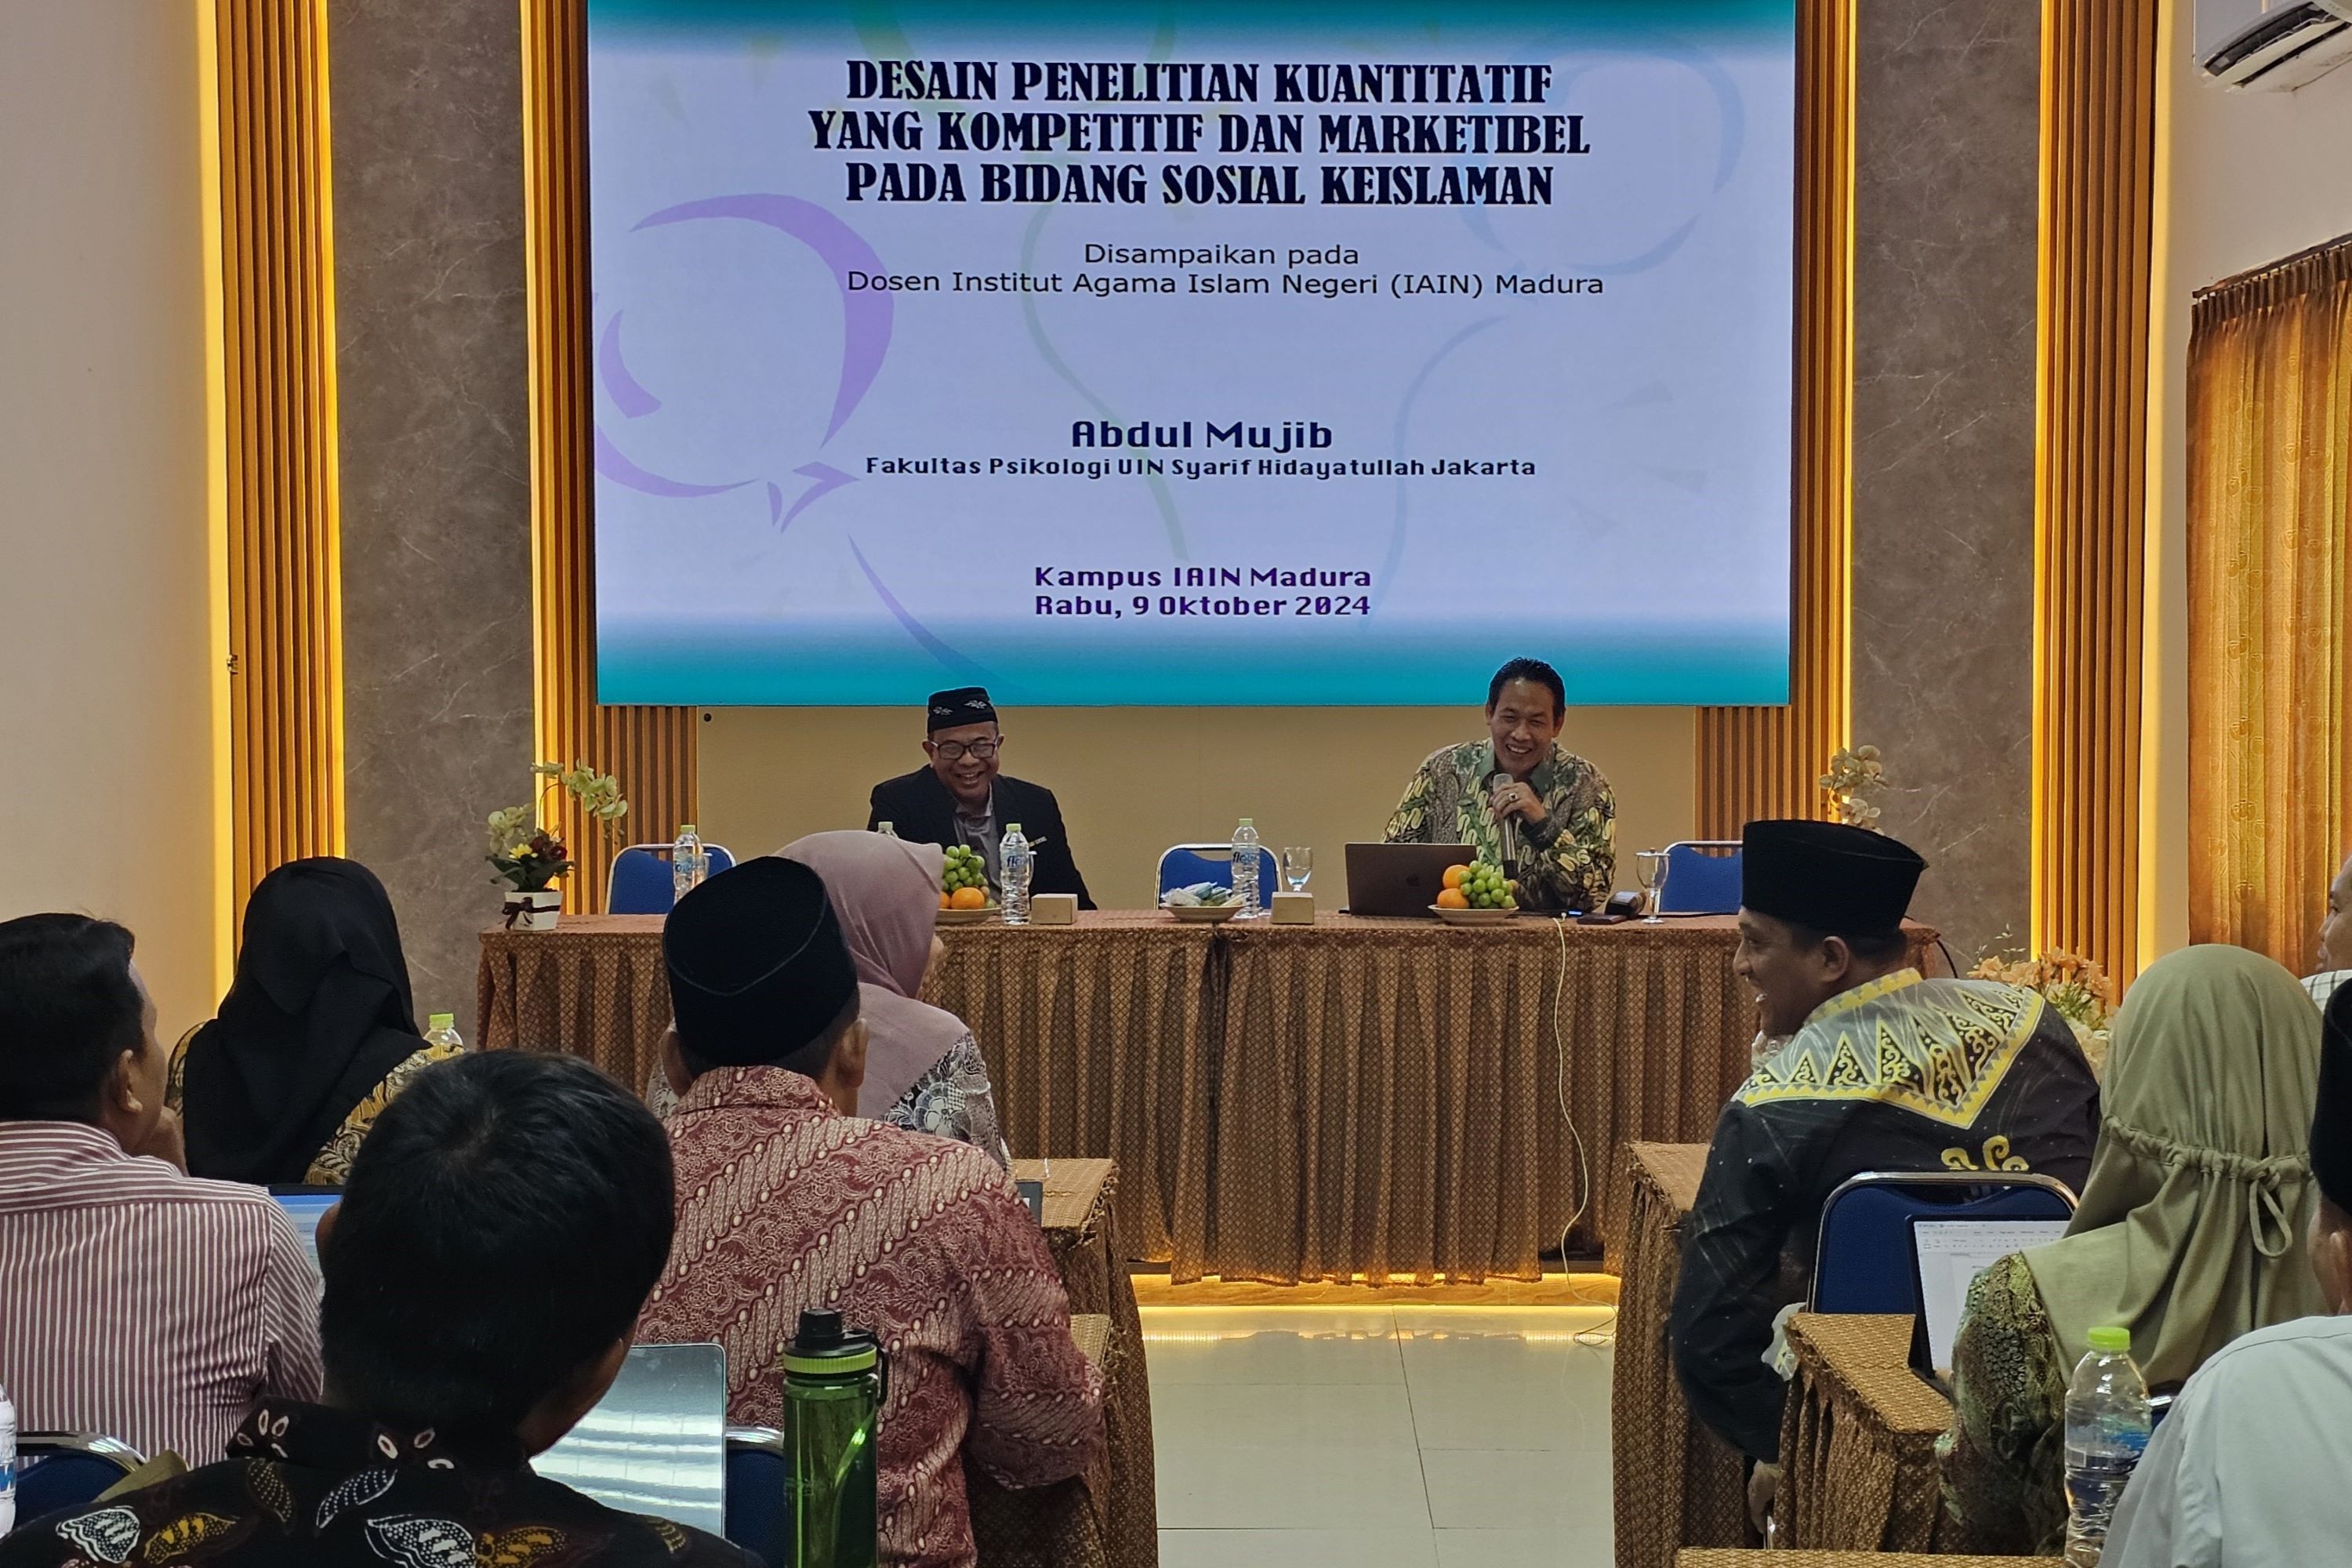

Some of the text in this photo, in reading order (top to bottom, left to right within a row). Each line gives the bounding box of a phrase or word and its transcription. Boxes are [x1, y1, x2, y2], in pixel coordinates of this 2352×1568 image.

[846, 60, 1552, 103] DESAIN PENELITIAN KUANTITATIF
[808, 110, 1591, 154] YANG KOMPETITIF DAN MARKETIBEL
[845, 162, 1554, 205] PADA BIDANG SOSIAL KEISLAMAN
[1085, 243, 1359, 270] Disampaikan pada
[848, 270, 1603, 299] Dosen Institut Agama Islam Negeri (IAIN) Madura
[1072, 420, 1332, 454] Abdul Mujib
[866, 457, 1535, 481] Fakultas Psikologi UIN Syarif Hidayatullah Jakarta
[1035, 567, 1370, 590] Kampus IAIN Madura
[1036, 595, 1370, 619] Rabu, 9 Oktober 2024
